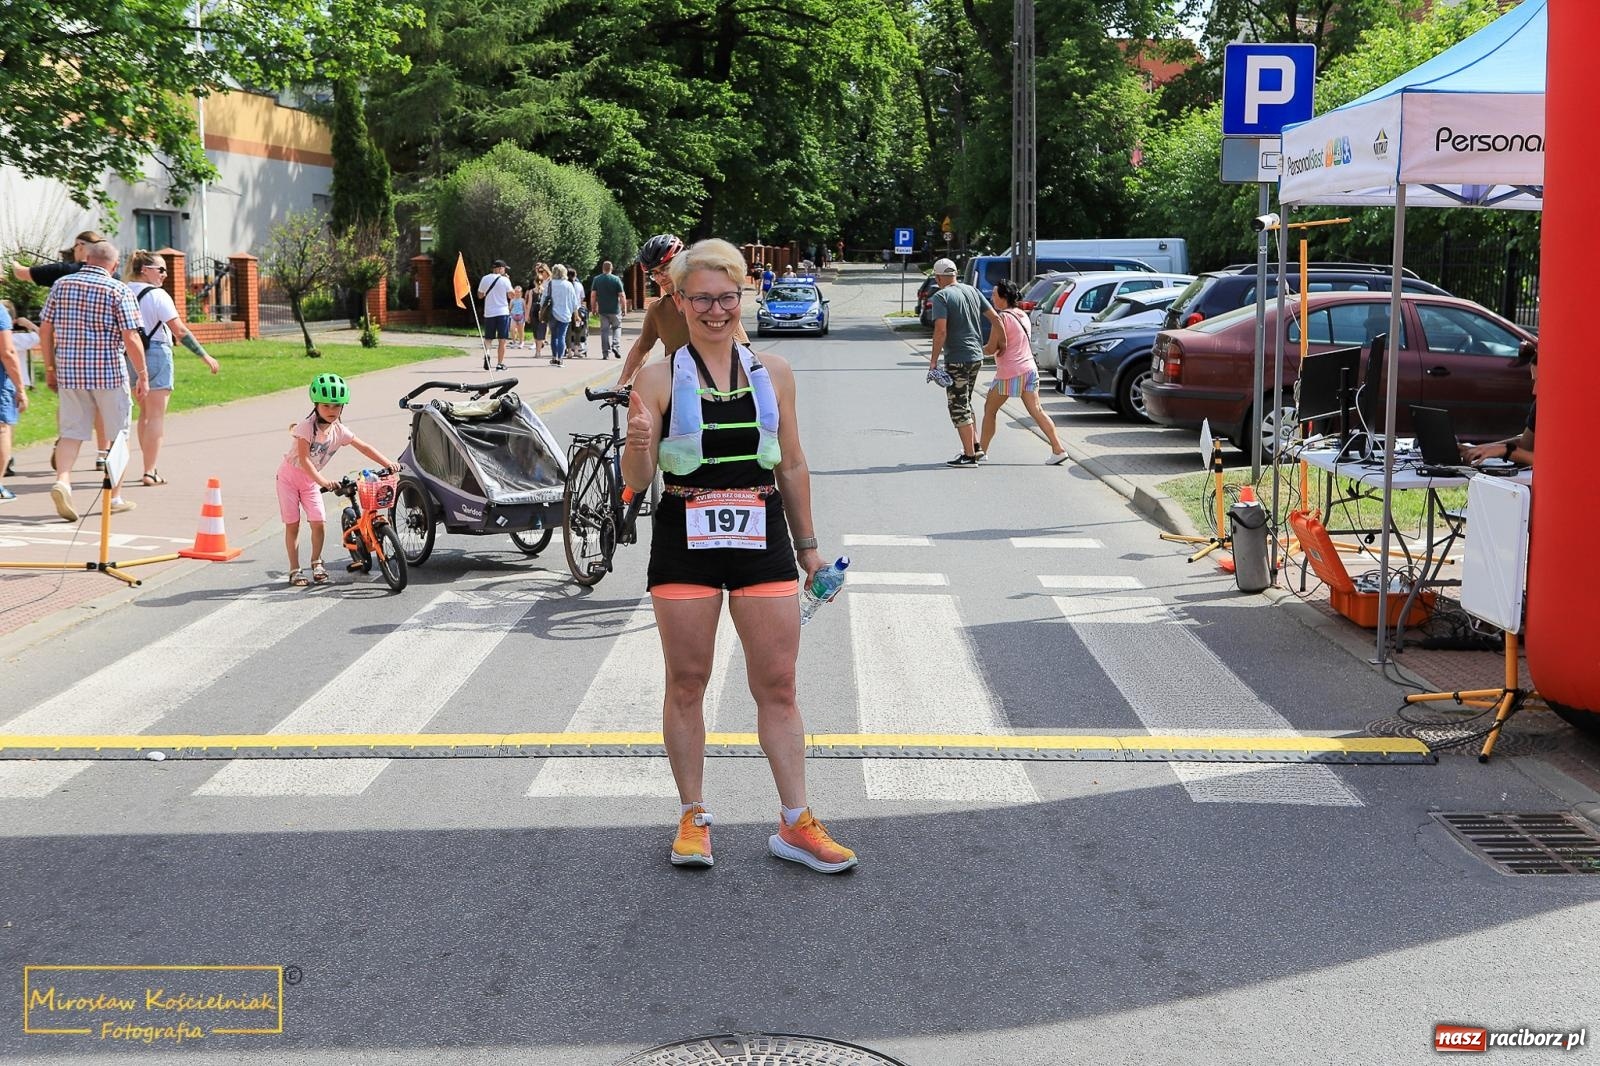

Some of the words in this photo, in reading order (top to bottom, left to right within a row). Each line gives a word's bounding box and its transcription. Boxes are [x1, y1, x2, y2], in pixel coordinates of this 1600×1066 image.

[1244, 55, 1296, 125] P
[899, 230, 910, 245] P
[705, 509, 750, 533] 197
